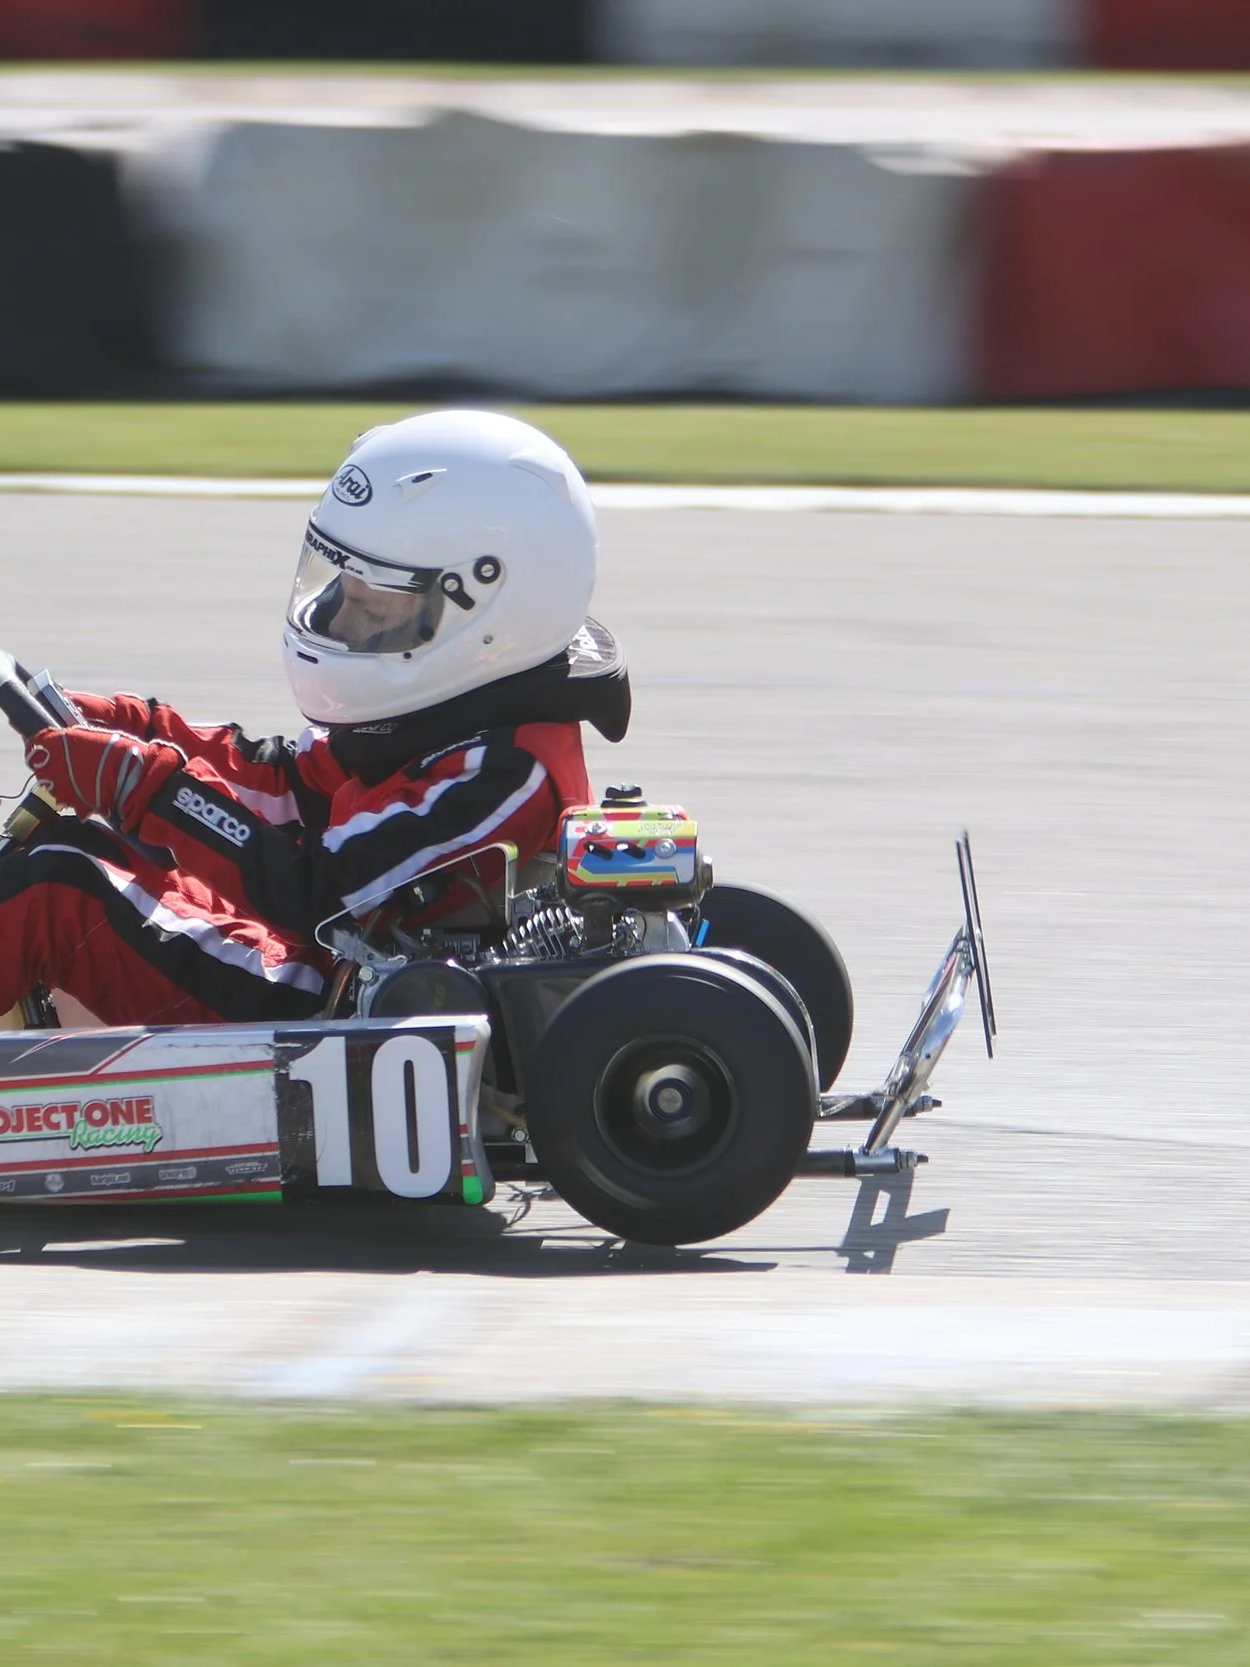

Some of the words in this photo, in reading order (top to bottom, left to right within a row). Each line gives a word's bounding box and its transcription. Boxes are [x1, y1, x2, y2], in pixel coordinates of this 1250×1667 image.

[338, 467, 370, 500] Arai
[175, 785, 252, 841] sparco
[82, 1097, 154, 1129] ONE
[289, 1035, 452, 1198] 10
[70, 1118, 162, 1150] Racing
